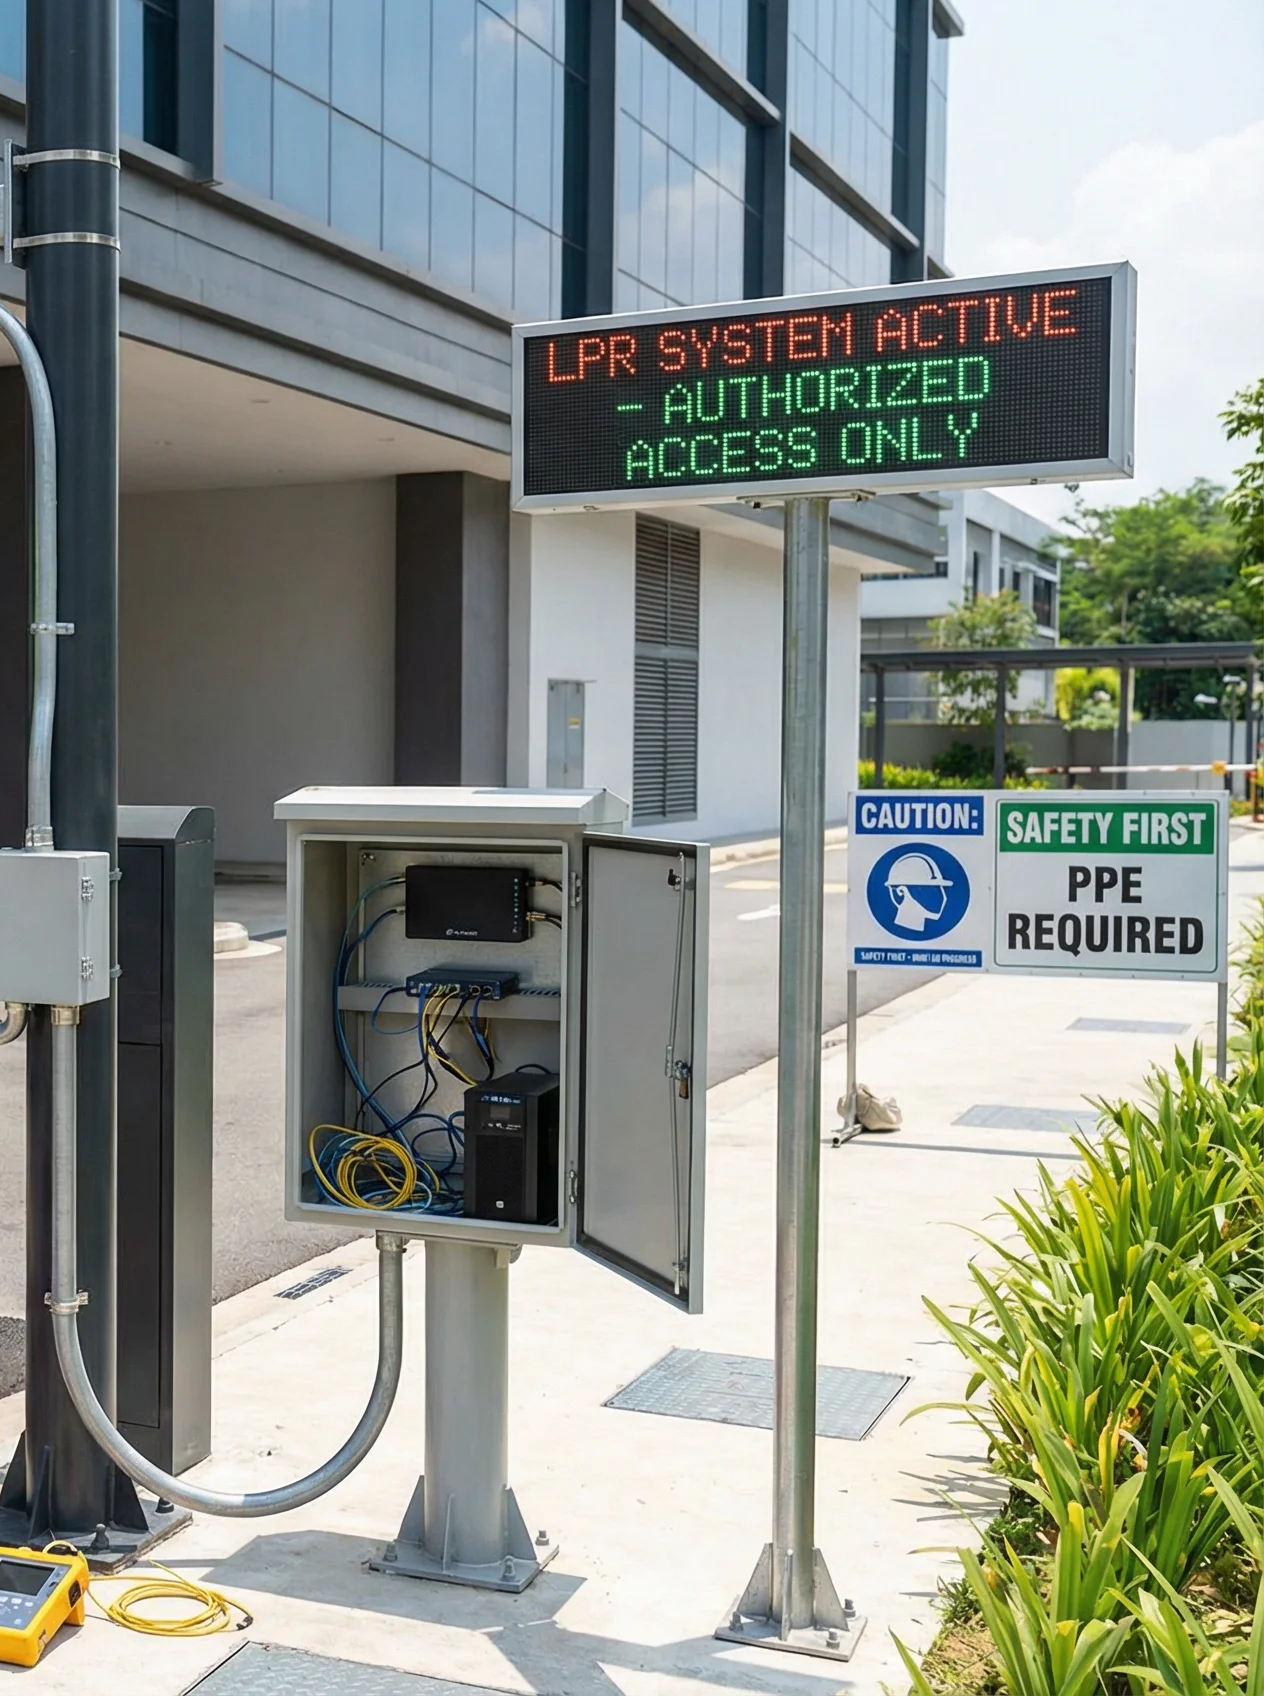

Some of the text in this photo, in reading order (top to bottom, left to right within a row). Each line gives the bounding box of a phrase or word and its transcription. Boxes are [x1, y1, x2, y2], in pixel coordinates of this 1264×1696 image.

[548, 288, 1079, 384] LPR SYSTEM ACTIVE
[664, 355, 991, 424] AUTHORIZED
[625, 412, 980, 481] ACCESS ONLY
[861, 802, 978, 830] CAUTION:
[1007, 811, 1207, 845] SAFETY FIRST
[1068, 865, 1142, 904] PPE
[1008, 913, 1203, 957] REQUIRED
